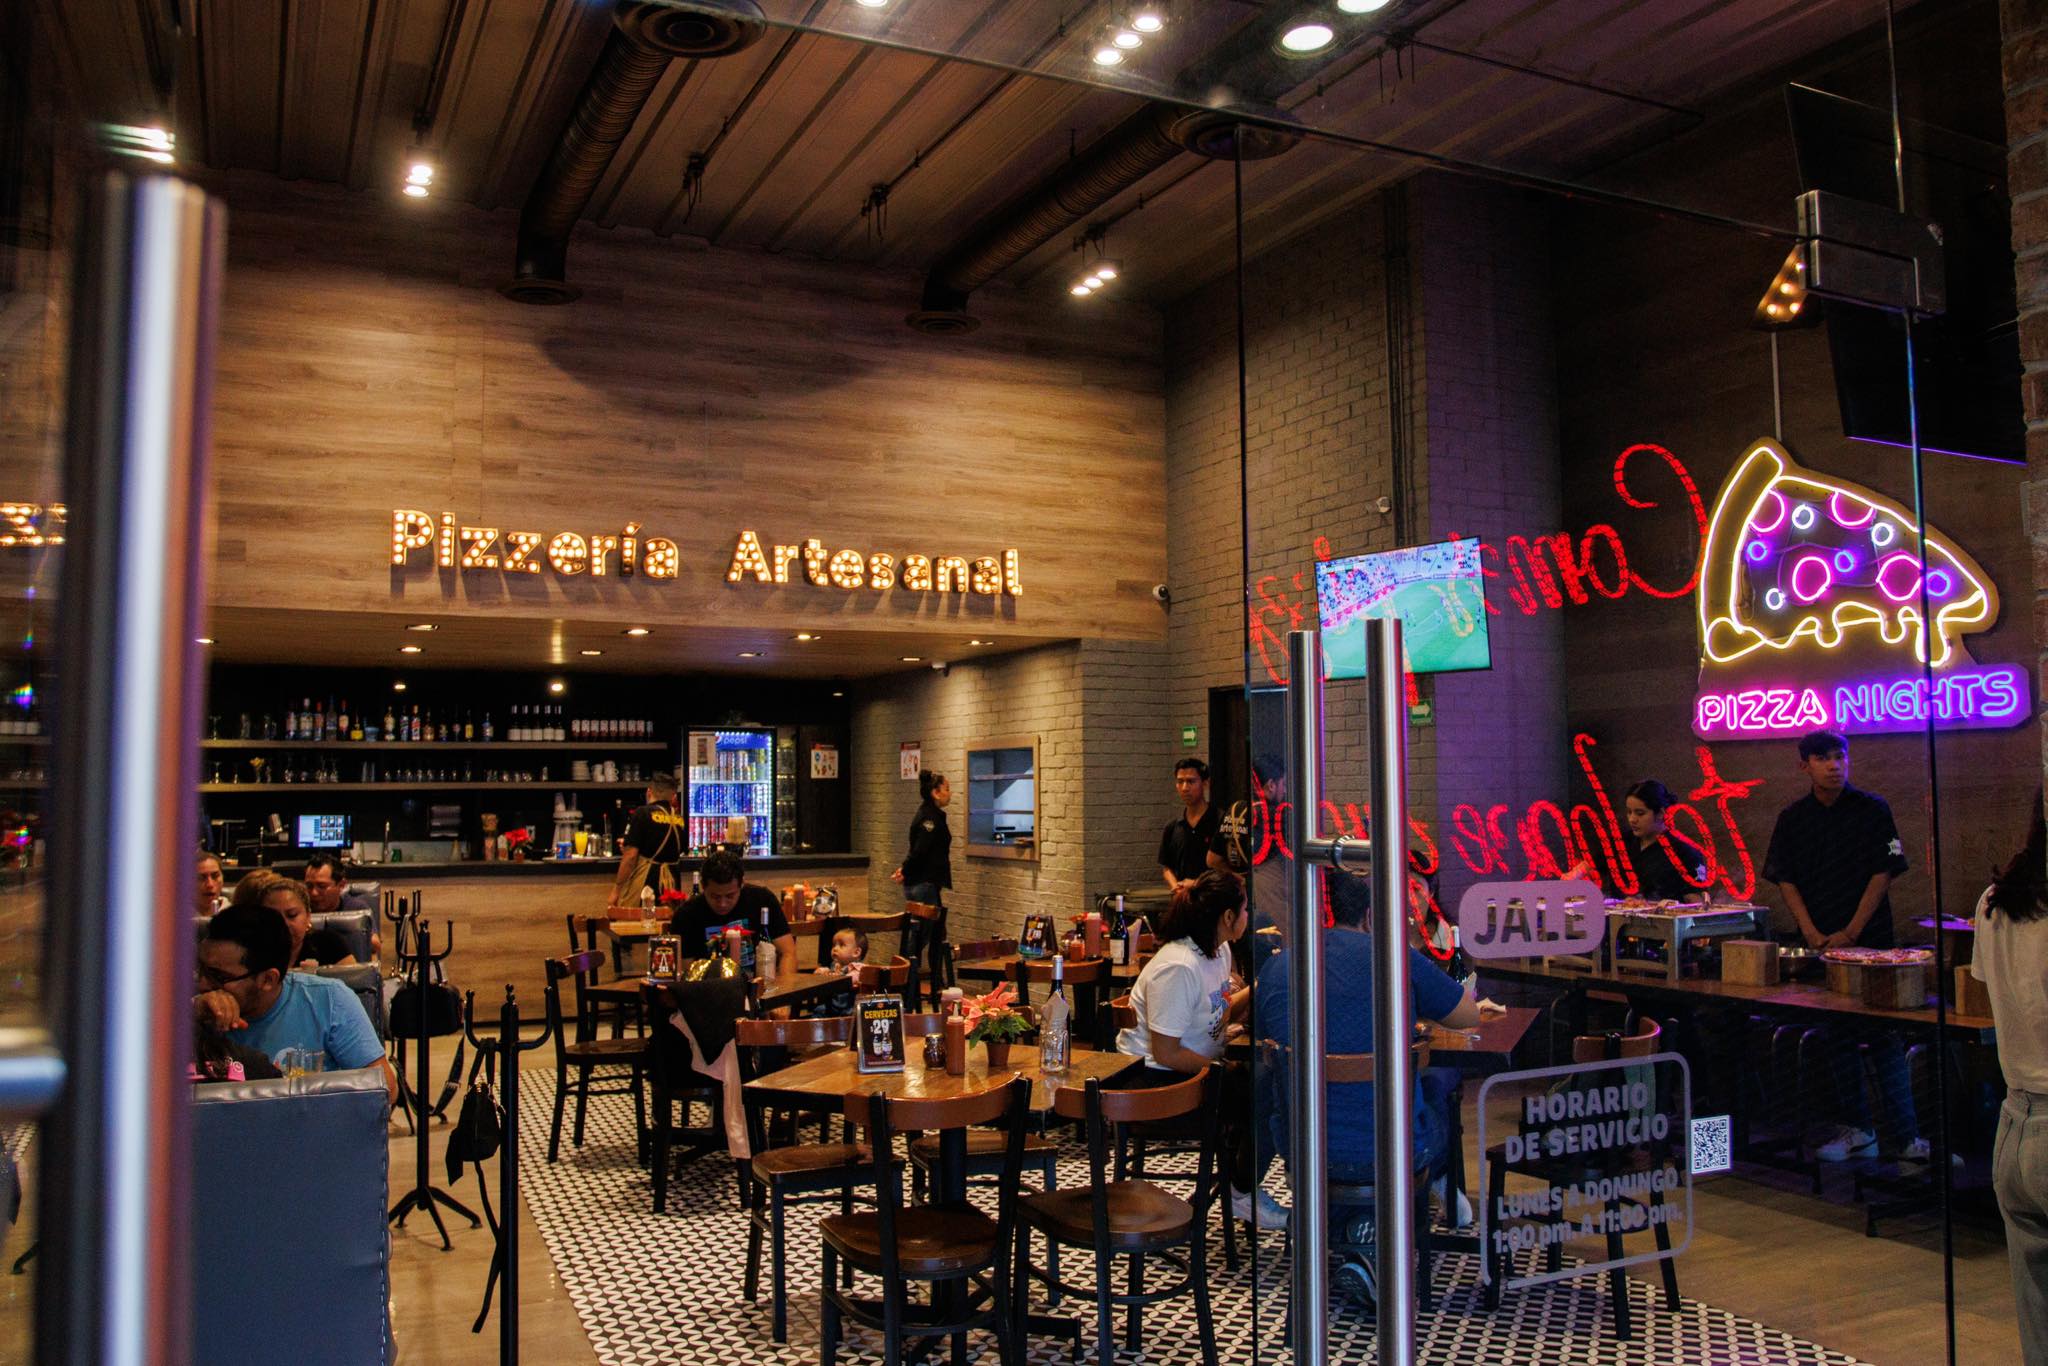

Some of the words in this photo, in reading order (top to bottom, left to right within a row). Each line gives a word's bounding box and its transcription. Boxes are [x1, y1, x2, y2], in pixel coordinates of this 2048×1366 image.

[391, 509, 679, 579] Pizzería
[726, 530, 1023, 596] Artesanal
[1698, 688, 1828, 731] PIZZA
[1835, 671, 2018, 723] NIGHTS
[723, 734, 747, 745] pepsi
[1474, 895, 1588, 945] JALE
[864, 1009, 898, 1019] CERVEZAS
[1525, 1081, 1649, 1125] HORARIO
[1505, 1131, 1541, 1164] DE
[1549, 1113, 1669, 1157] SERVICIO
[1496, 1187, 1563, 1221] LUNES
[1568, 1183, 1580, 1208] A
[1584, 1168, 1679, 1207] DOMINGO
[1493, 1224, 1536, 1254] 1:00
[1580, 1214, 1594, 1236] A
